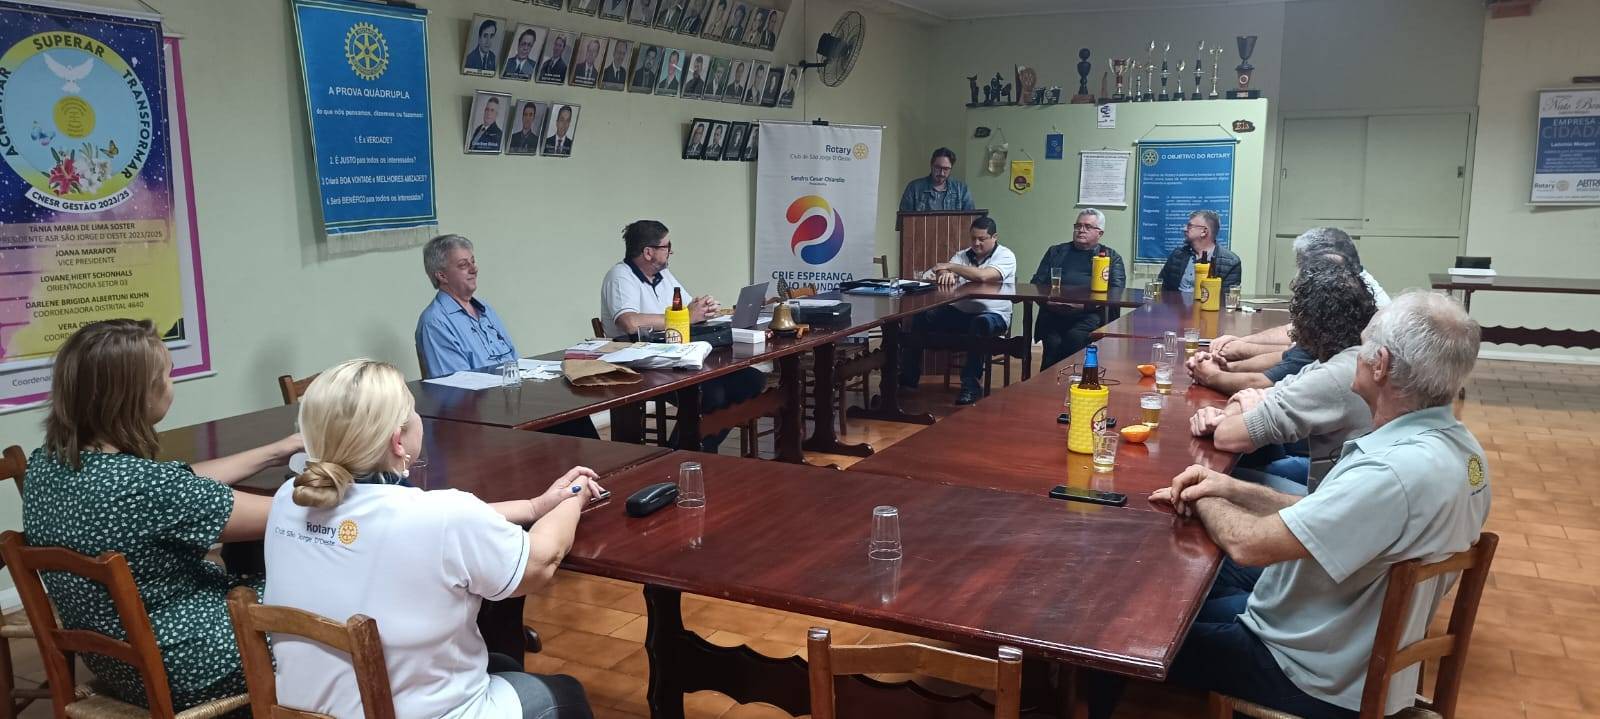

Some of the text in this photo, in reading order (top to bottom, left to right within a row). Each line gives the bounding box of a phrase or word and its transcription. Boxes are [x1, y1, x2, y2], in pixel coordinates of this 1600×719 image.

[32, 34, 105, 58] SUPERAR
[328, 86, 335, 95] A
[336, 86, 363, 97] PROVA
[121, 69, 151, 179] TRANSFORMAR
[825, 144, 852, 155] Rotary
[32, 190, 130, 211] CNESR GESTÃO 2023/25
[54, 224, 79, 232] MARIA
[91, 223, 109, 231] LIMA
[60, 232, 76, 241] SÃO
[55, 247, 117, 257] JOANA MARAFON
[57, 256, 116, 267] VICE PRESIDENTE
[40, 274, 71, 283] LOVANE
[772, 271, 853, 282] CRIE ESPERANÇA
[46, 281, 97, 292] ORIENTADORA
[97, 280, 119, 289] SETOR
[25, 300, 60, 310] DARLENE
[61, 297, 91, 306] BRIGIDA
[33, 305, 94, 318] COORDENADORA
[94, 302, 127, 312] DISTRITAL
[58, 323, 78, 331] VERA
[306, 521, 336, 539] Rotary
